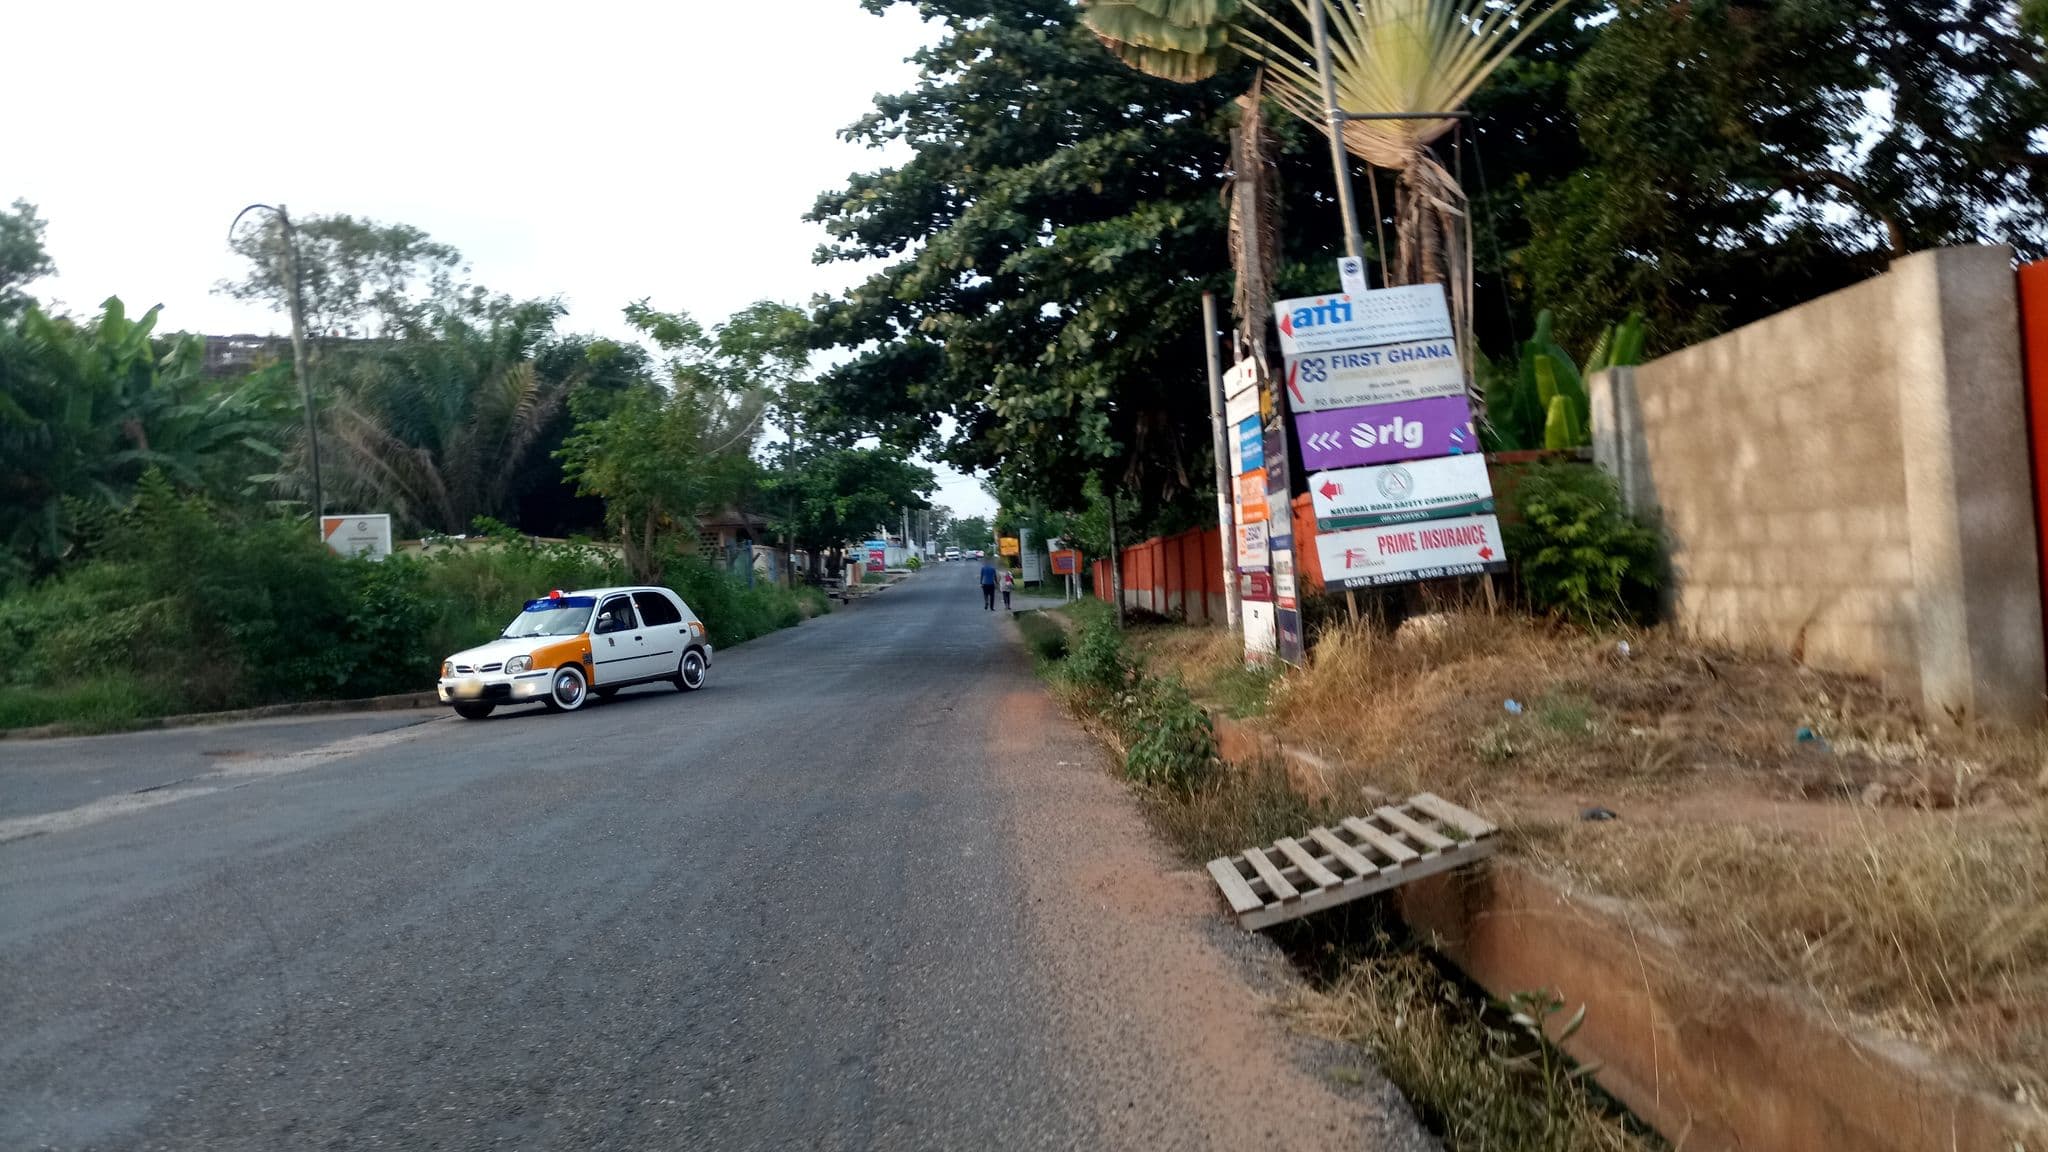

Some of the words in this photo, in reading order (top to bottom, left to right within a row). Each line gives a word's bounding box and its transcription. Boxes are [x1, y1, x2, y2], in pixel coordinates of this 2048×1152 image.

[1332, 352, 1382, 370] FIRST
[1387, 344, 1452, 363] GHANA
[1378, 416, 1424, 448] rlg
[1330, 506, 1369, 515] NATIONAL
[1370, 503, 1393, 512] ROAD
[1394, 500, 1423, 510] SAFETY
[1424, 493, 1479, 505] COMMISSION
[1377, 531, 1418, 556] PRIME
[1419, 524, 1487, 550] INSURANCE
